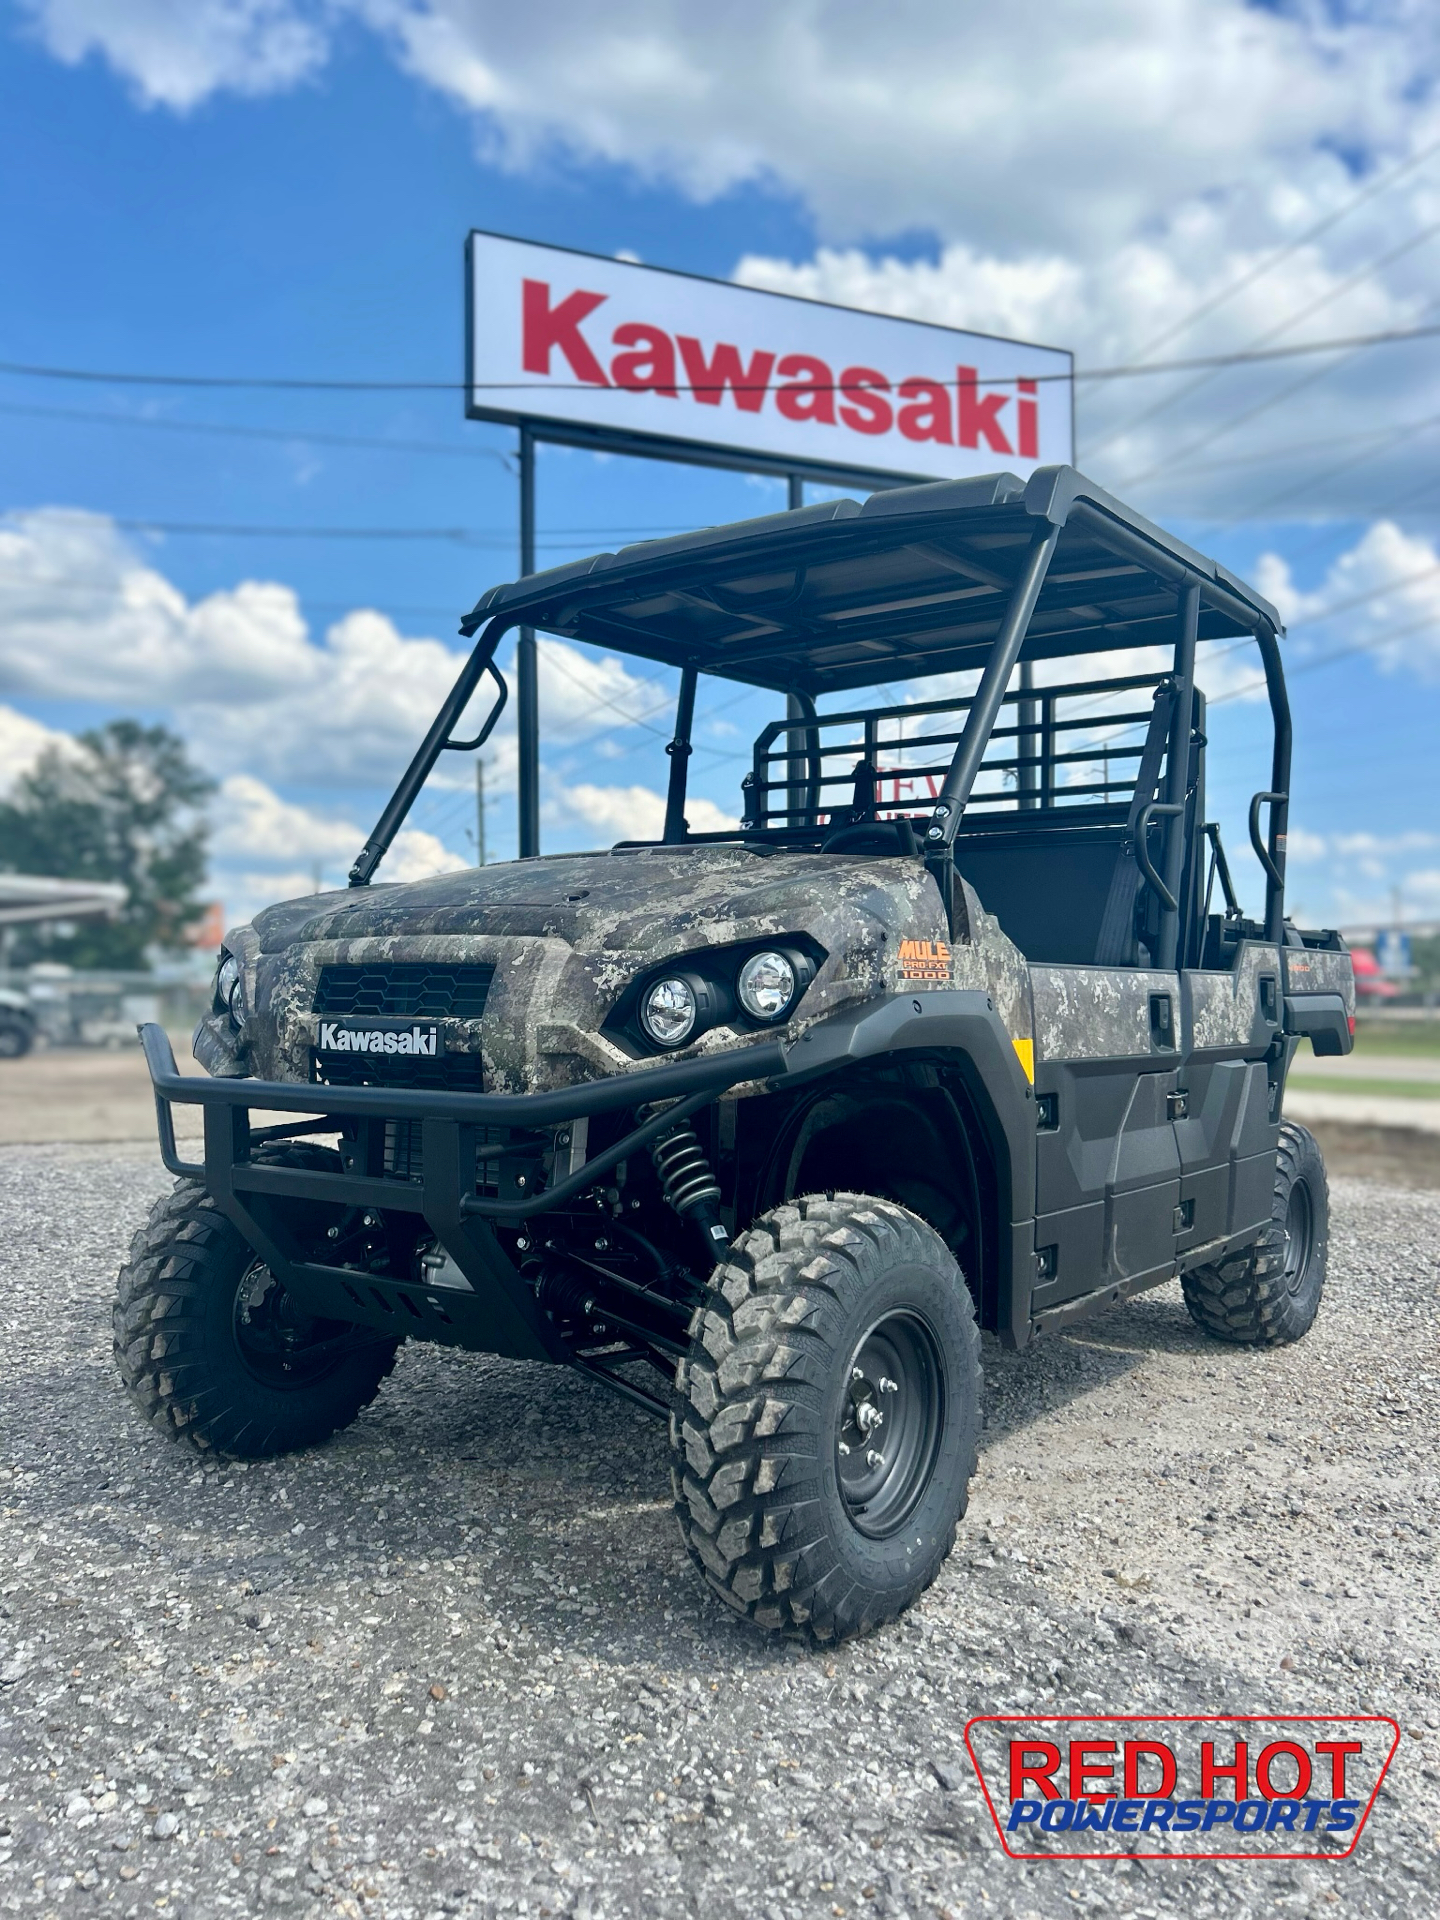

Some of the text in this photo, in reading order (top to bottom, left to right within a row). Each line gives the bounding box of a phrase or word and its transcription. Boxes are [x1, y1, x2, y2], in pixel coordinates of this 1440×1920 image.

[521, 277, 1040, 459] Kawasaki
[897, 939, 951, 961] MULE
[902, 970, 950, 979] 1000
[320, 1023, 437, 1056] Kawasaki
